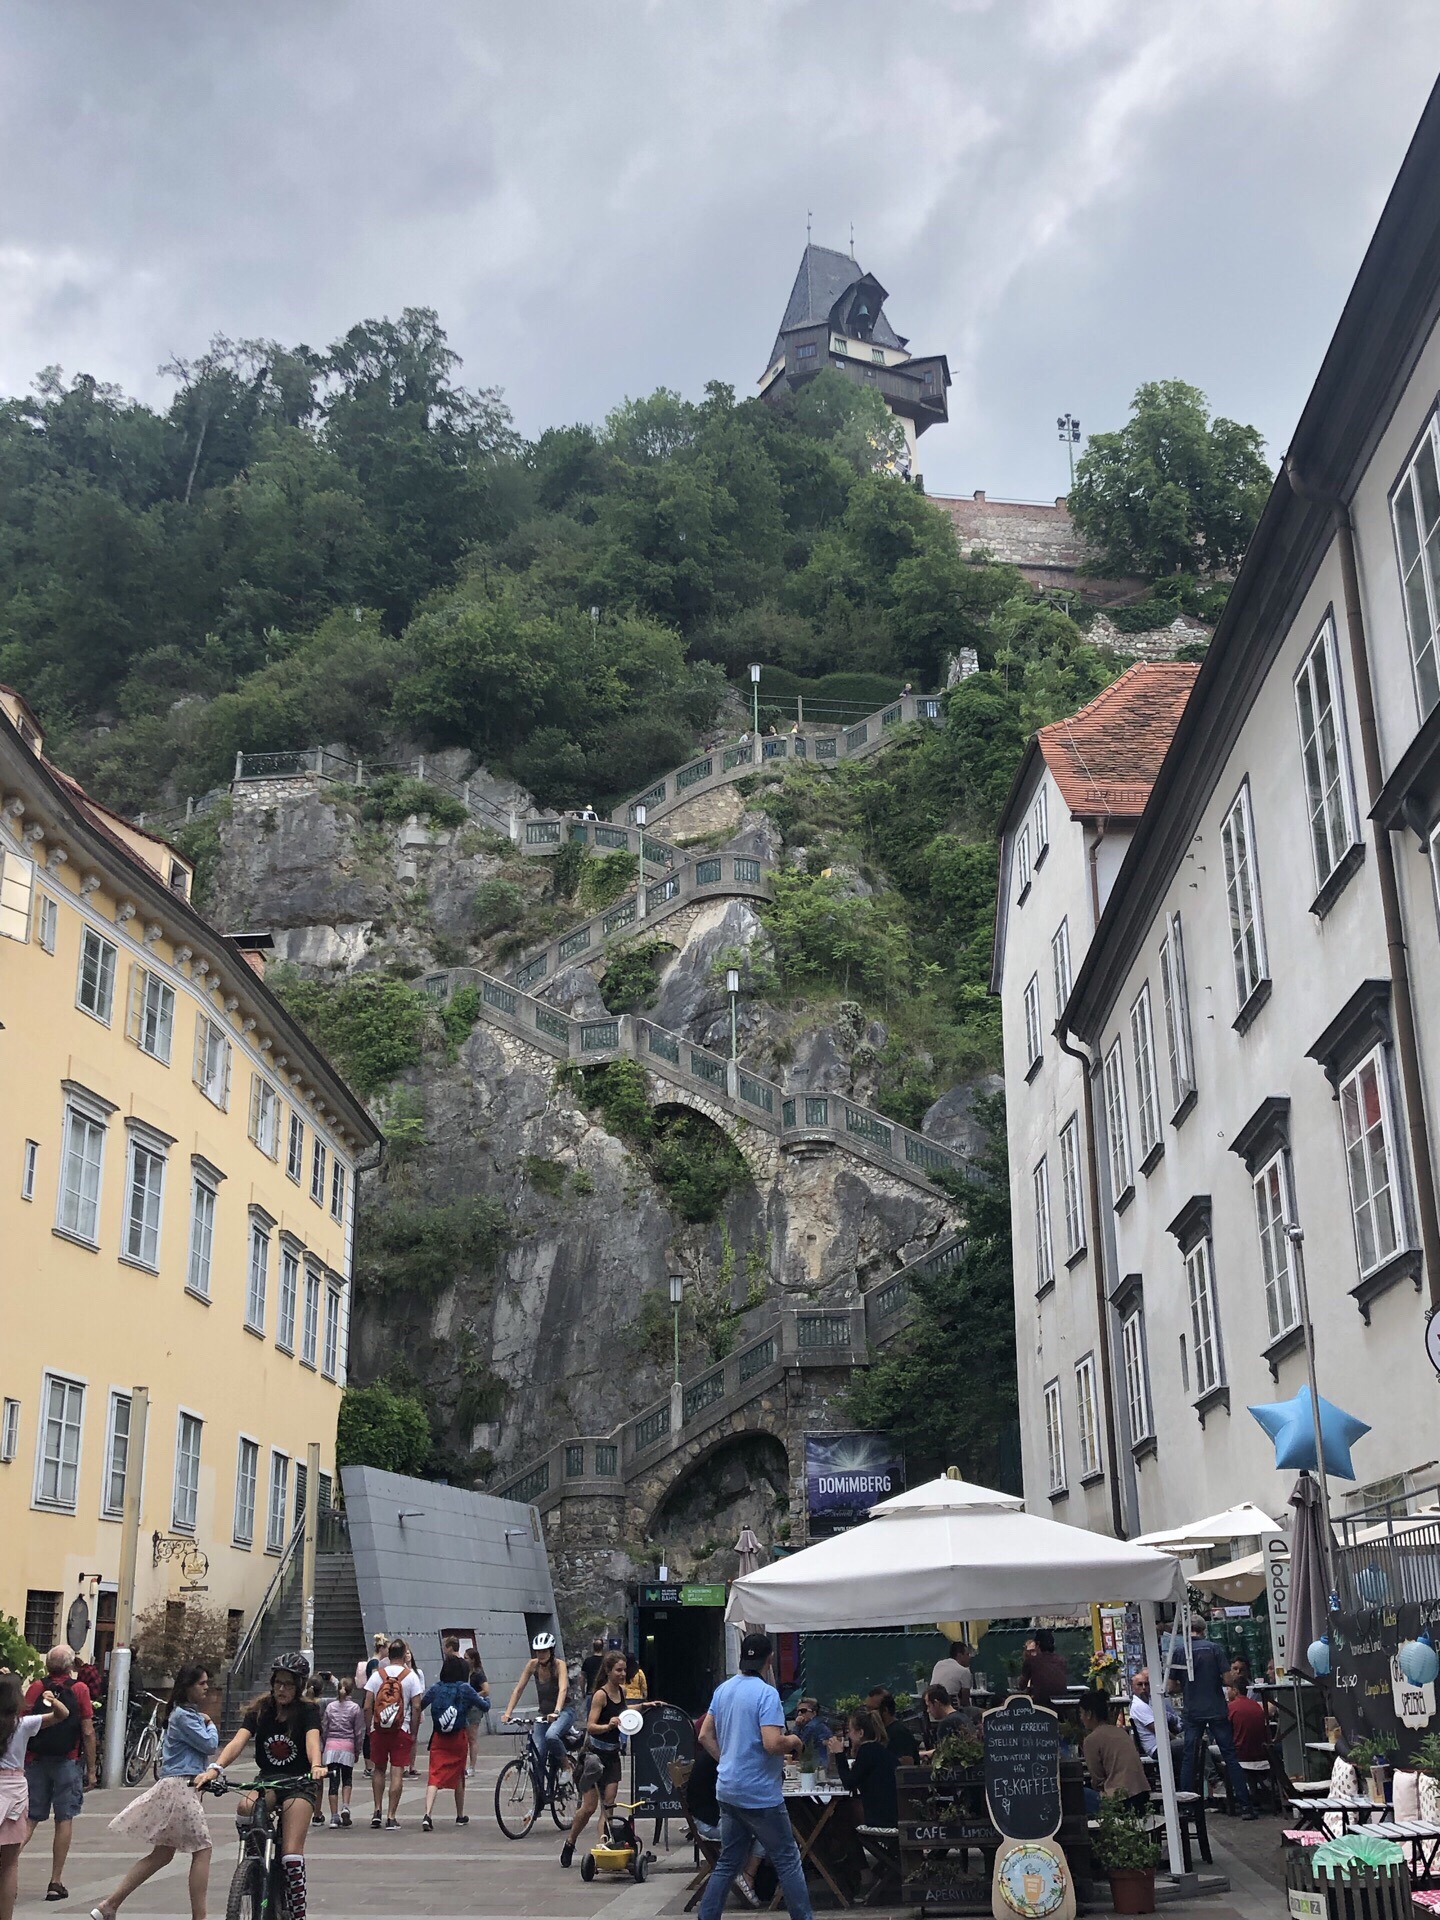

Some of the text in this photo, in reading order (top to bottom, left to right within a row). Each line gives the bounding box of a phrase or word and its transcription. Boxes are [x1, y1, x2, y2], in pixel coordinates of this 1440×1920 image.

[379, 1702, 400, 1722] NIKE
[438, 1705, 458, 1728] NIKE
[965, 1770, 985, 1781] LEO
[915, 1826, 993, 1839] CAFE LIMON
